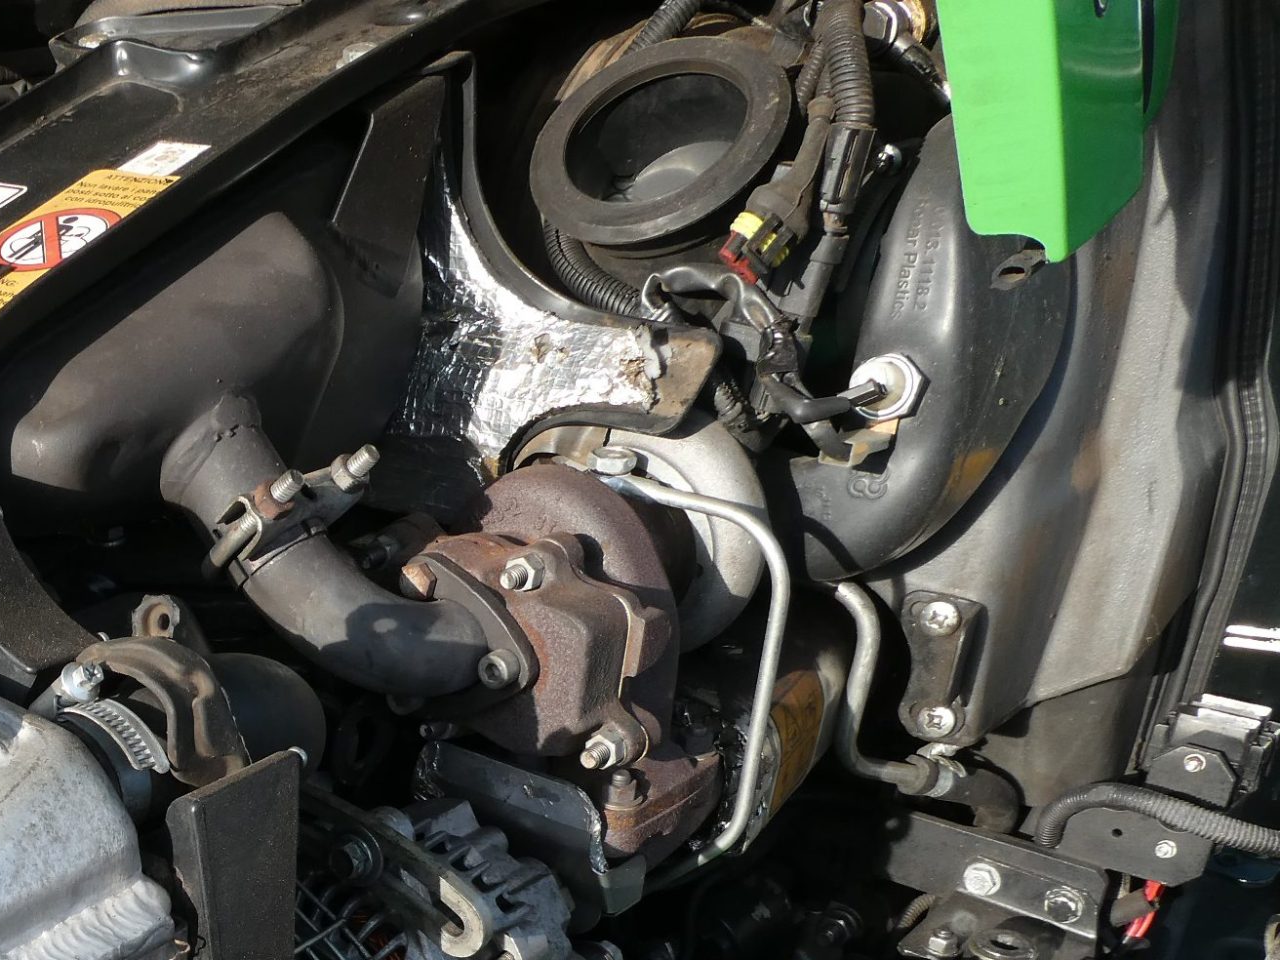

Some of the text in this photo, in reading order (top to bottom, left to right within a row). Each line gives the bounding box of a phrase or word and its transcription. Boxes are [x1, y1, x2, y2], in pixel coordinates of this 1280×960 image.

[106, 174, 174, 186] ATTENZION
[93, 191, 120, 199] sotto
[890, 252, 919, 321] Plastics
